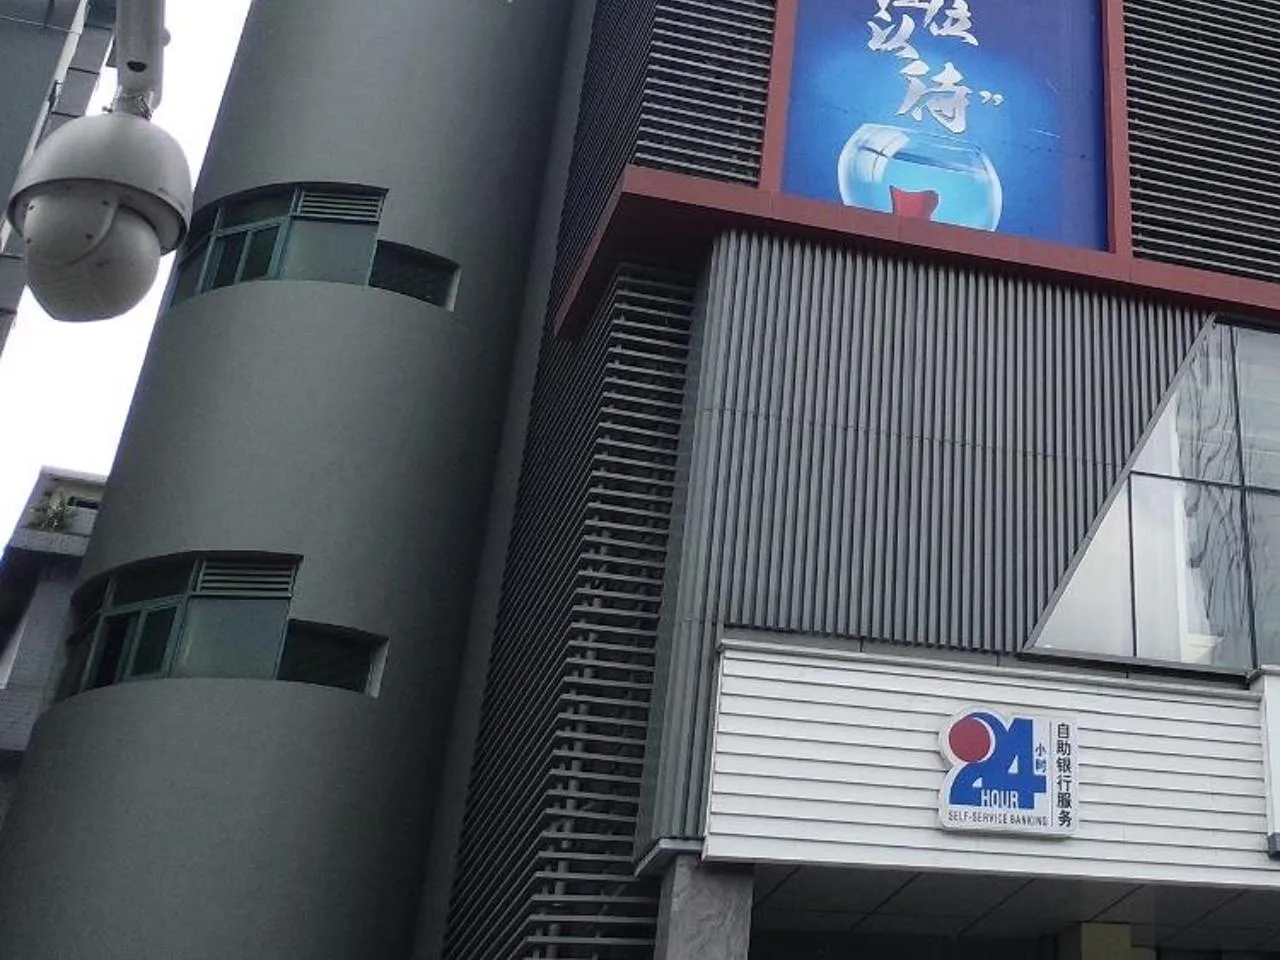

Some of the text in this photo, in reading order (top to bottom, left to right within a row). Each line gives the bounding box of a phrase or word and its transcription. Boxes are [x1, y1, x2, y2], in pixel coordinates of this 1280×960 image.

[949, 712, 1047, 809] 24
[1056, 723, 1073, 827] 自助银行服务
[948, 810, 1049, 827] SELF-SERVICE BANKING
[980, 788, 1019, 809] HOUR
